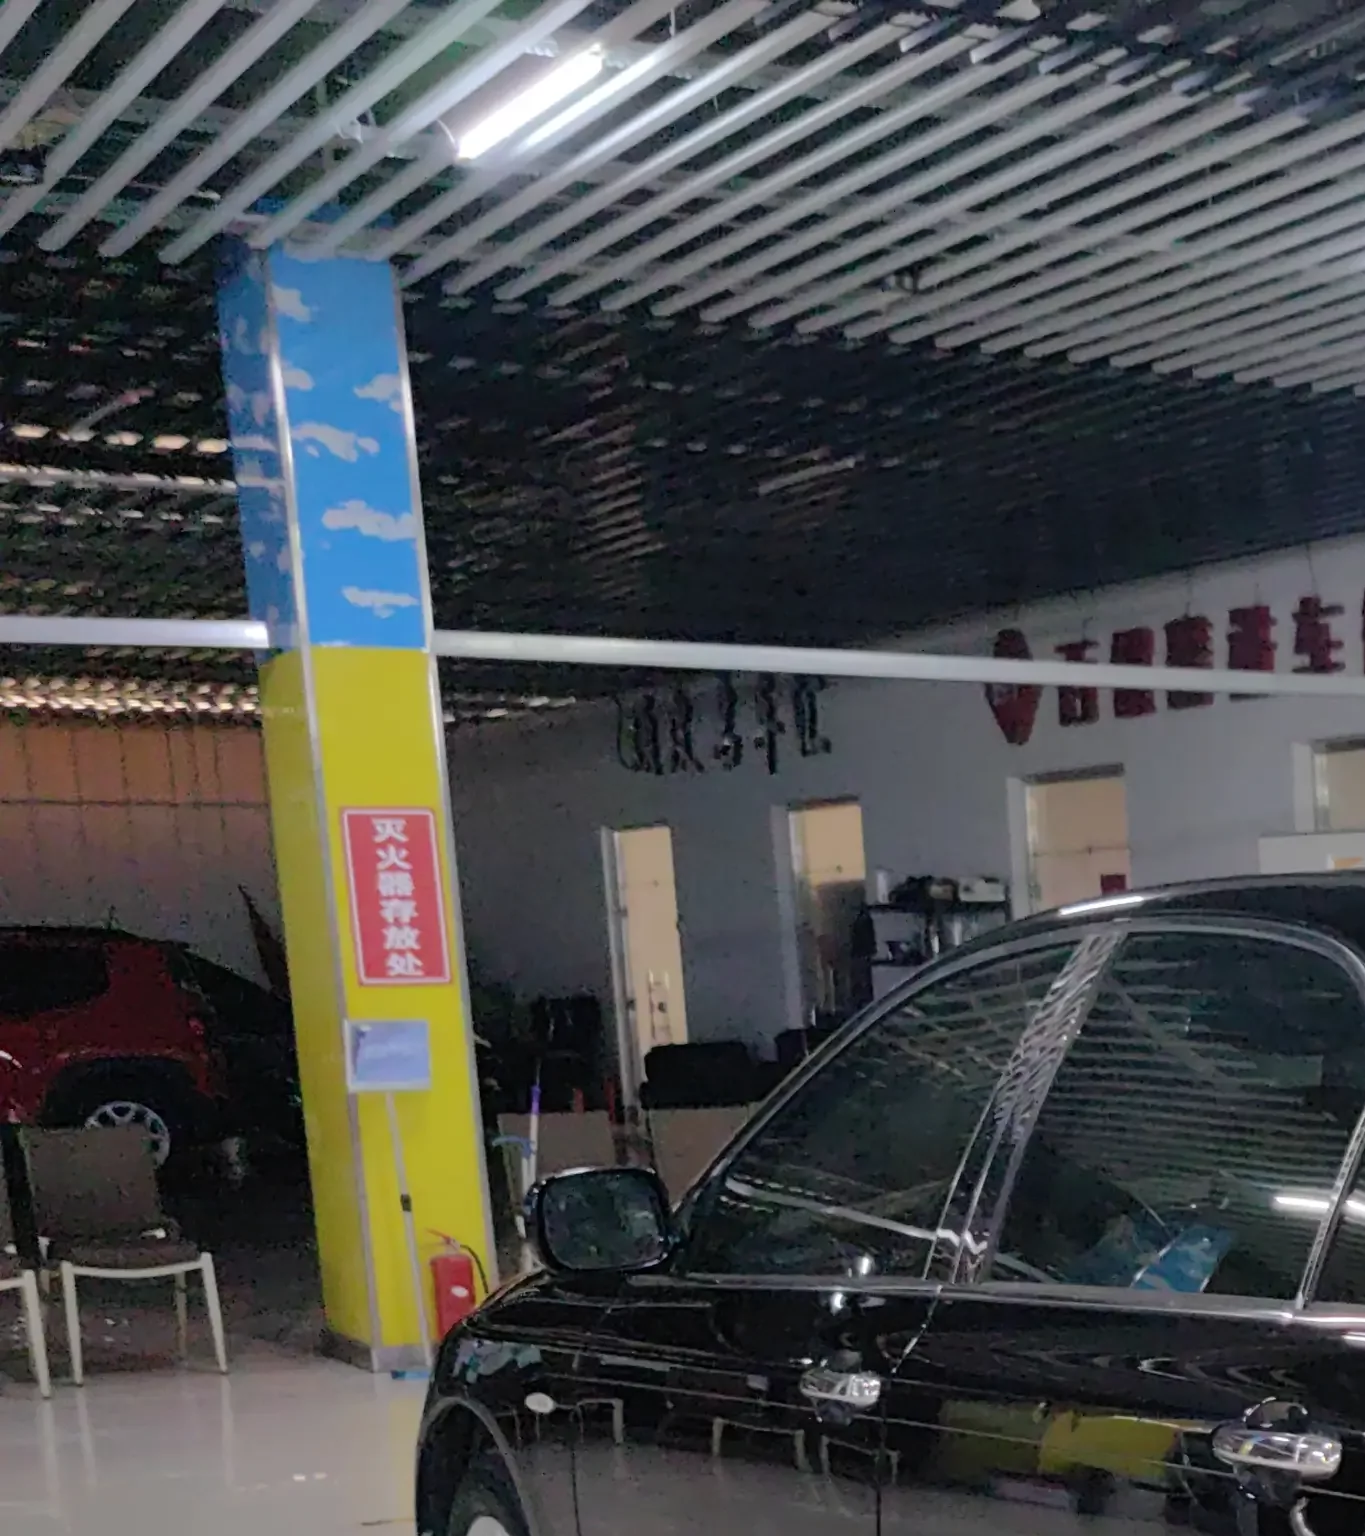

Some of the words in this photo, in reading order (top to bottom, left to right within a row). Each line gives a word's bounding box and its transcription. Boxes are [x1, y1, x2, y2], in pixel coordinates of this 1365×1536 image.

[372, 818, 424, 977] 灭火器存放处
